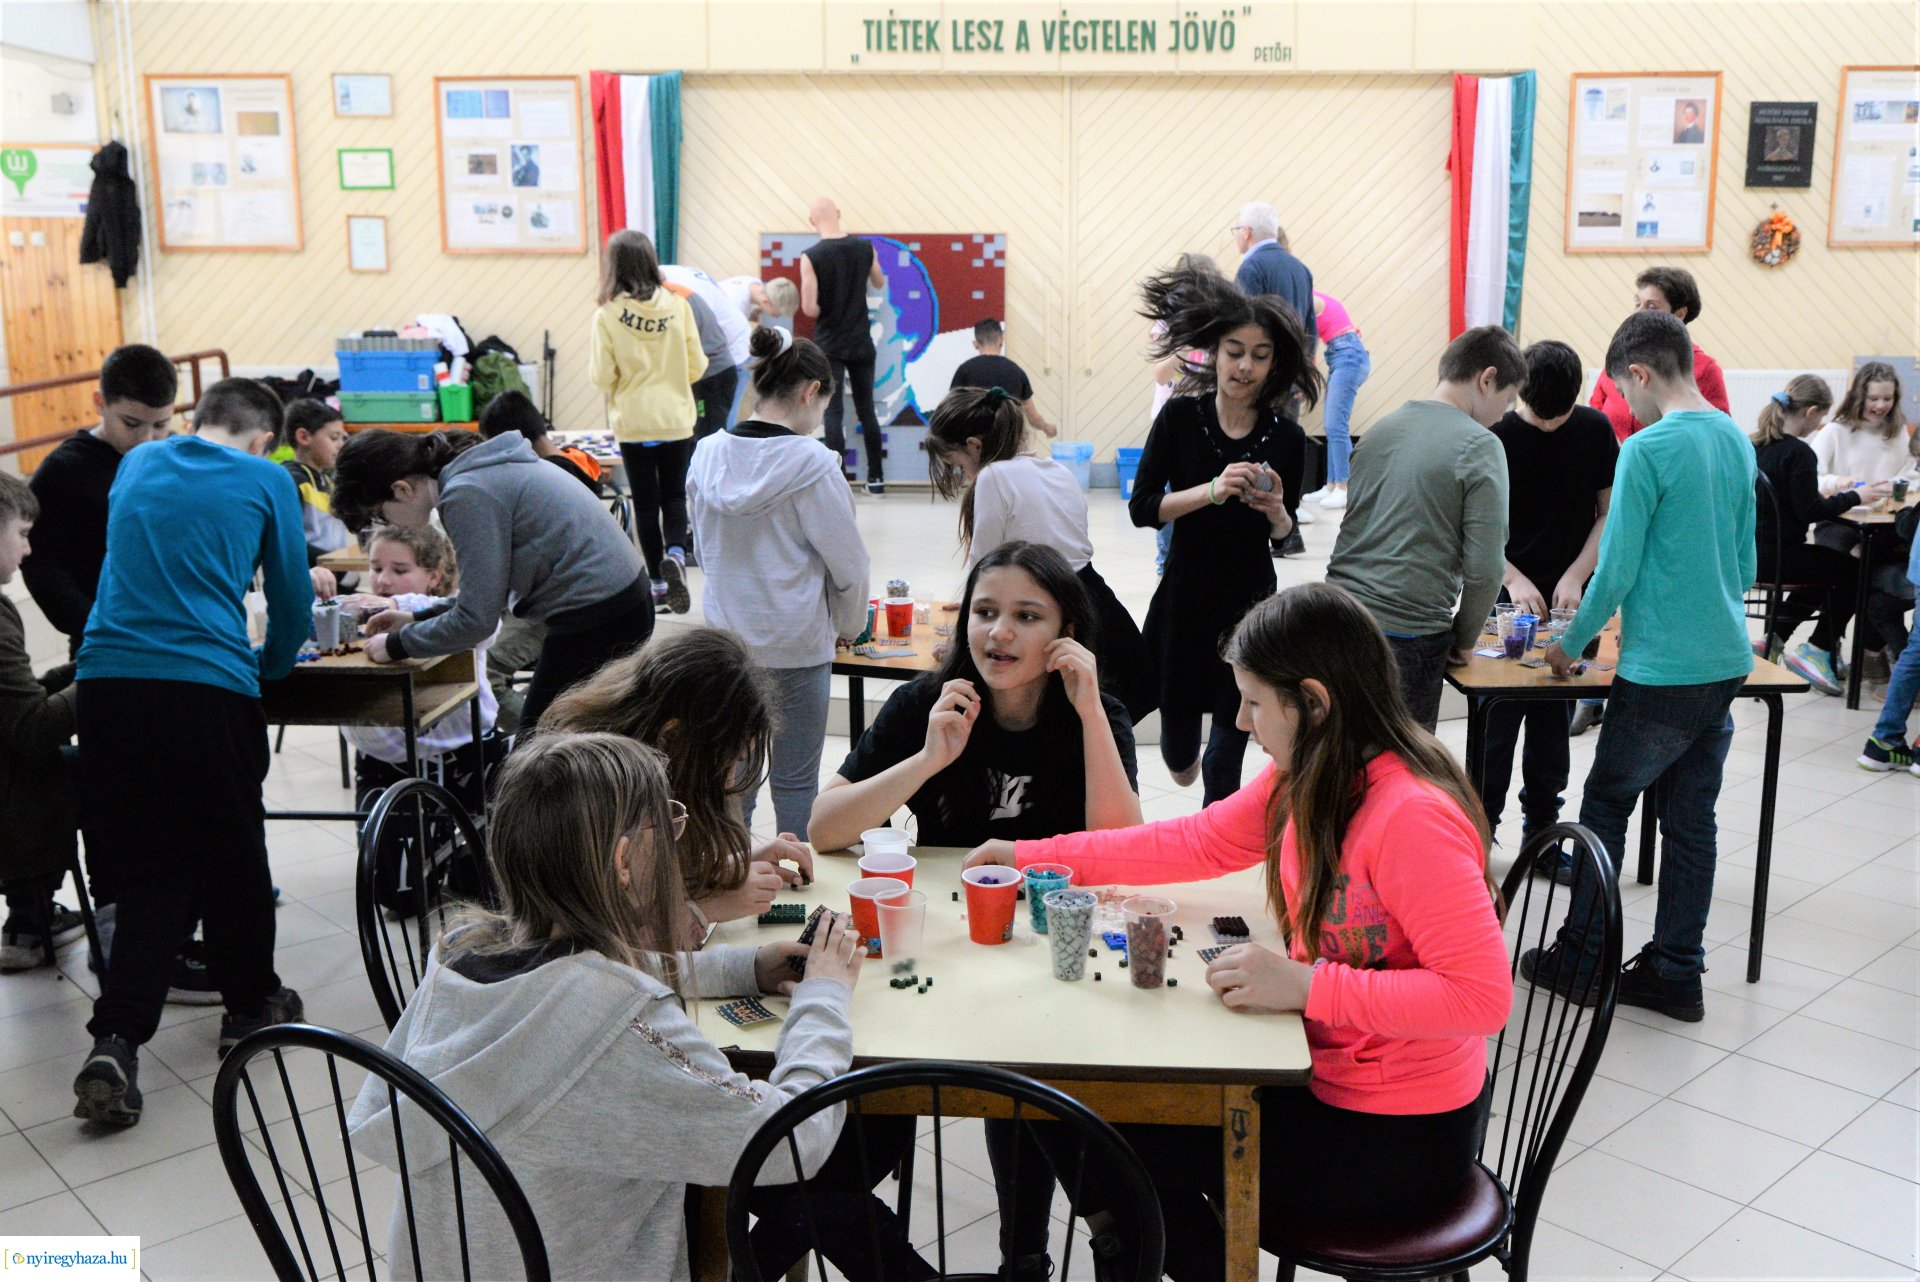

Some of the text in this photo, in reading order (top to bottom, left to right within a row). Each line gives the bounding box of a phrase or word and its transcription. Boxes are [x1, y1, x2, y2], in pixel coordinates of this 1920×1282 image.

[952, 20, 1004, 51] LESZ
[1015, 20, 1030, 51] A
[1042, 9, 1157, 52] VÉGTELEN
